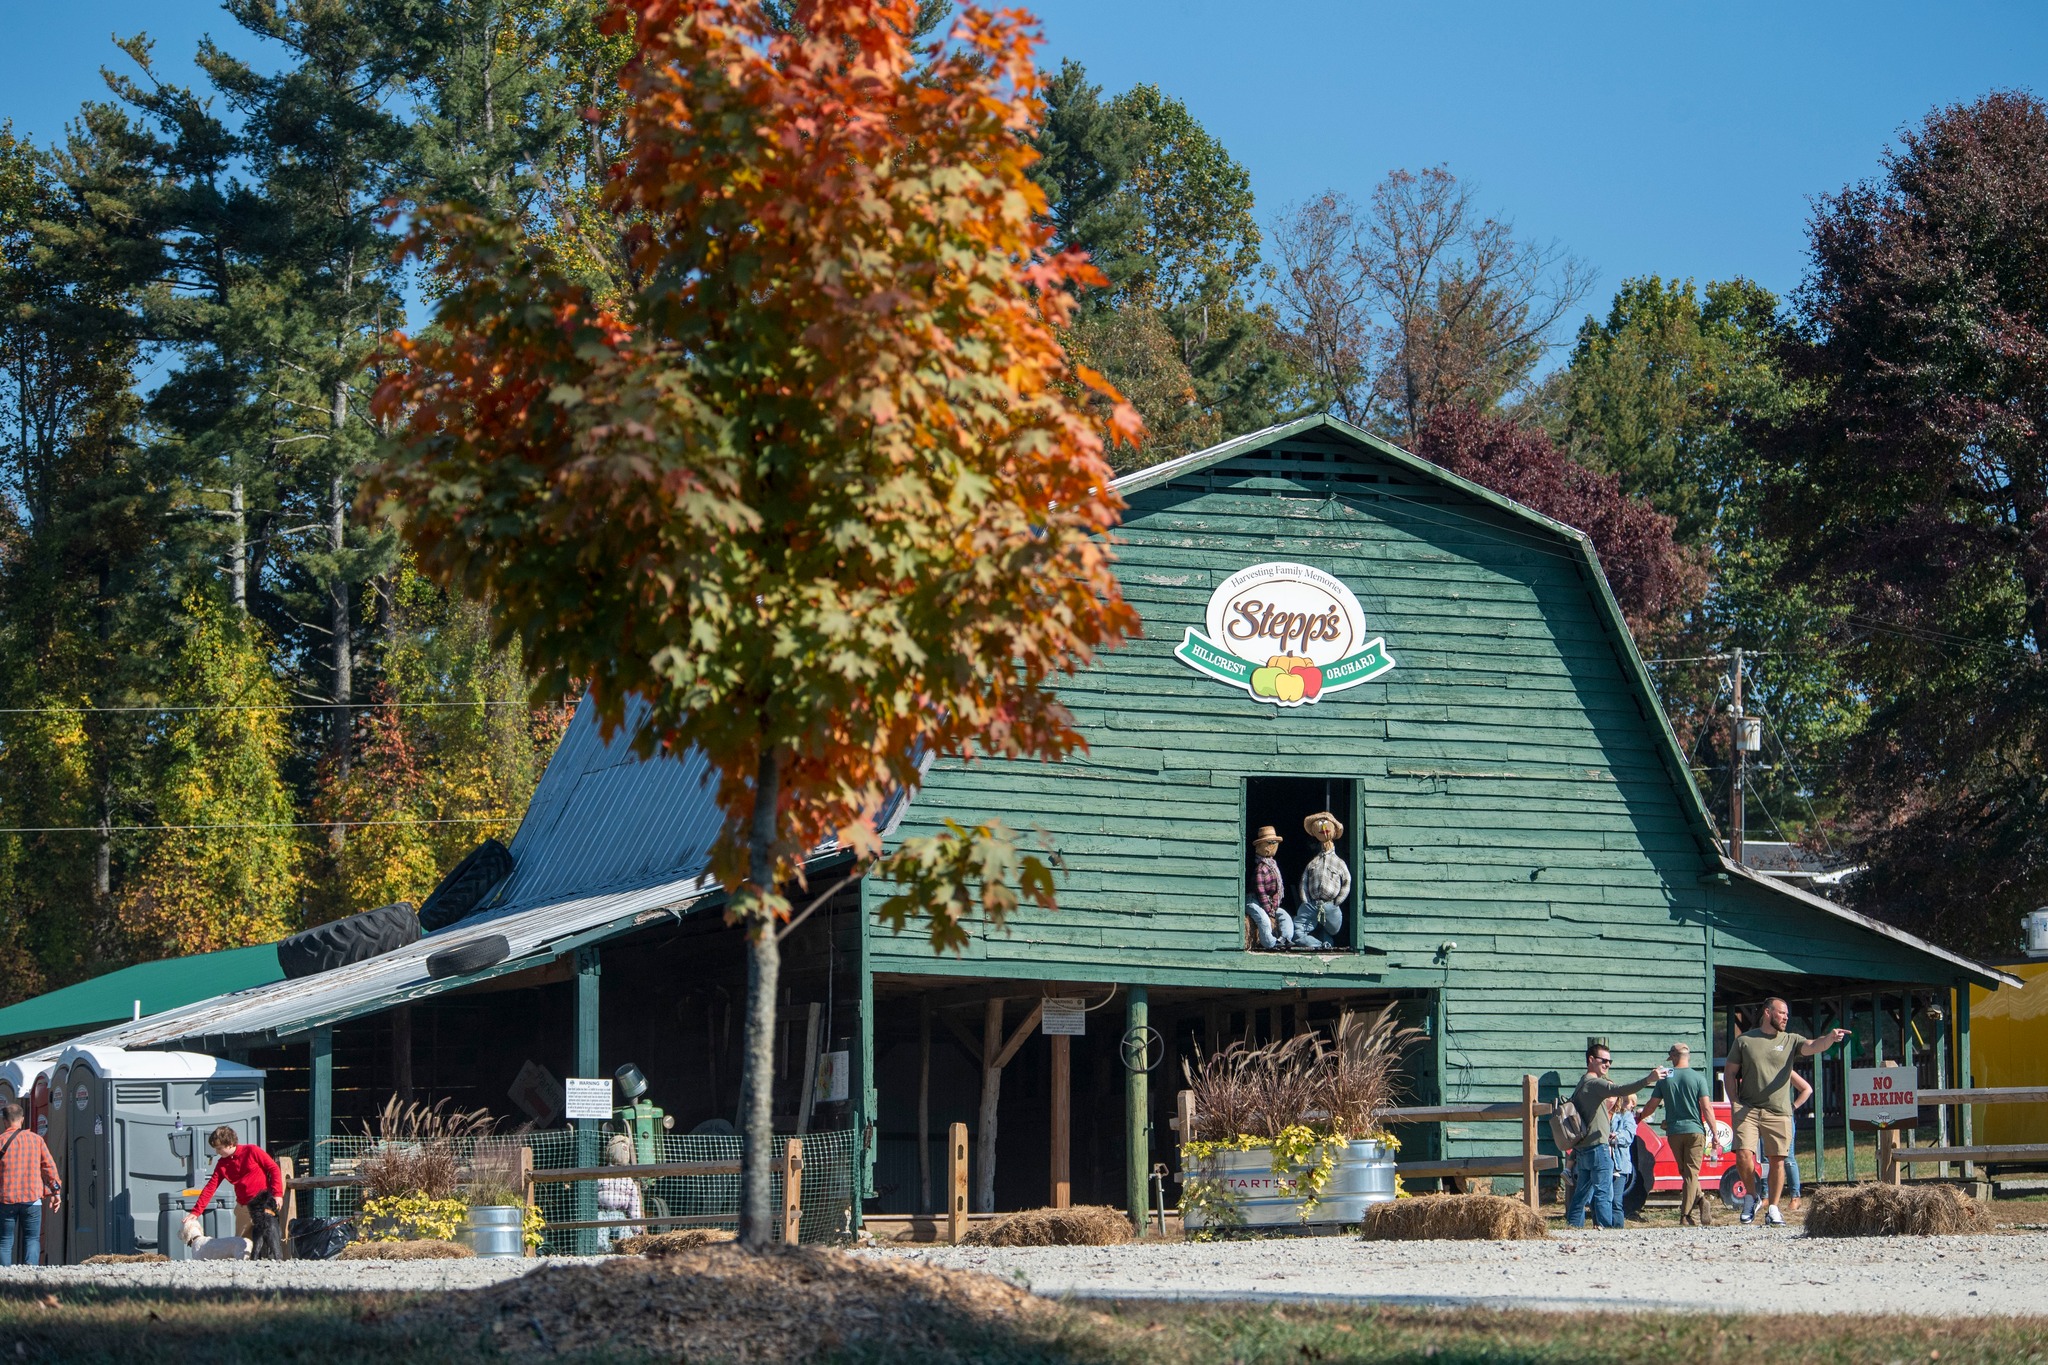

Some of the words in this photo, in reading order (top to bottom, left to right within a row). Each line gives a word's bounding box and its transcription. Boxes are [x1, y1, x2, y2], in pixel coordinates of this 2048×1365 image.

[1231, 566, 1274, 588] Harvesting
[1275, 565, 1303, 579] Family
[1304, 568, 1343, 595] Memories
[1227, 600, 1341, 653] Stepp's
[1191, 643, 1247, 676] HILLCREST
[1326, 653, 1376, 680] ORCHARD
[1873, 1076, 1893, 1090] NO
[1852, 1091, 1914, 1107] PARKING
